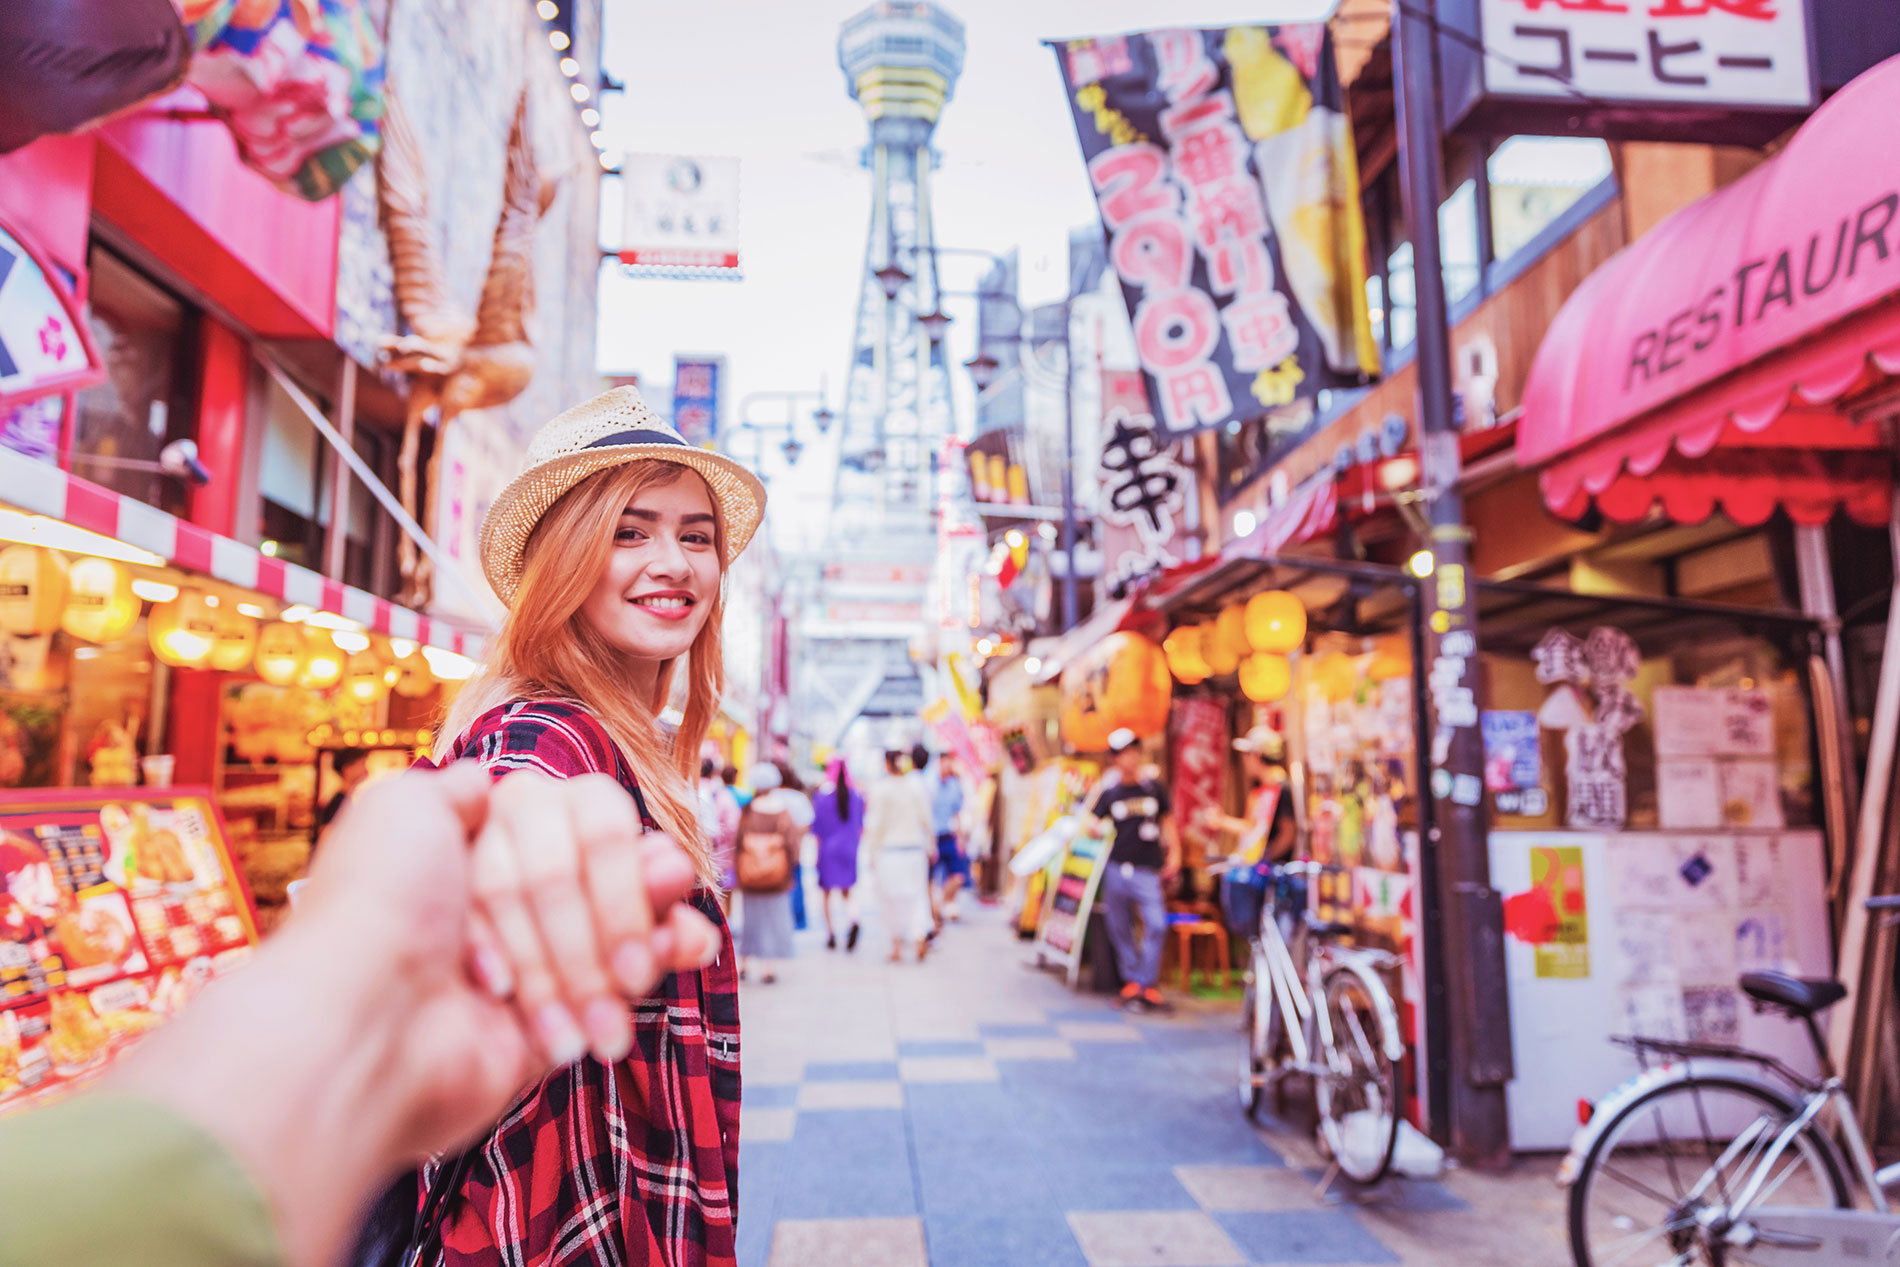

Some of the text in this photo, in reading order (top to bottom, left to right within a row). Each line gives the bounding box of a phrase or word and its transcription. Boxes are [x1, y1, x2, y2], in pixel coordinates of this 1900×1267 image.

[1515, 26, 1772, 84] コーヒー
[1089, 144, 1233, 430] 290円
[1622, 193, 1900, 393] RESTAUR
